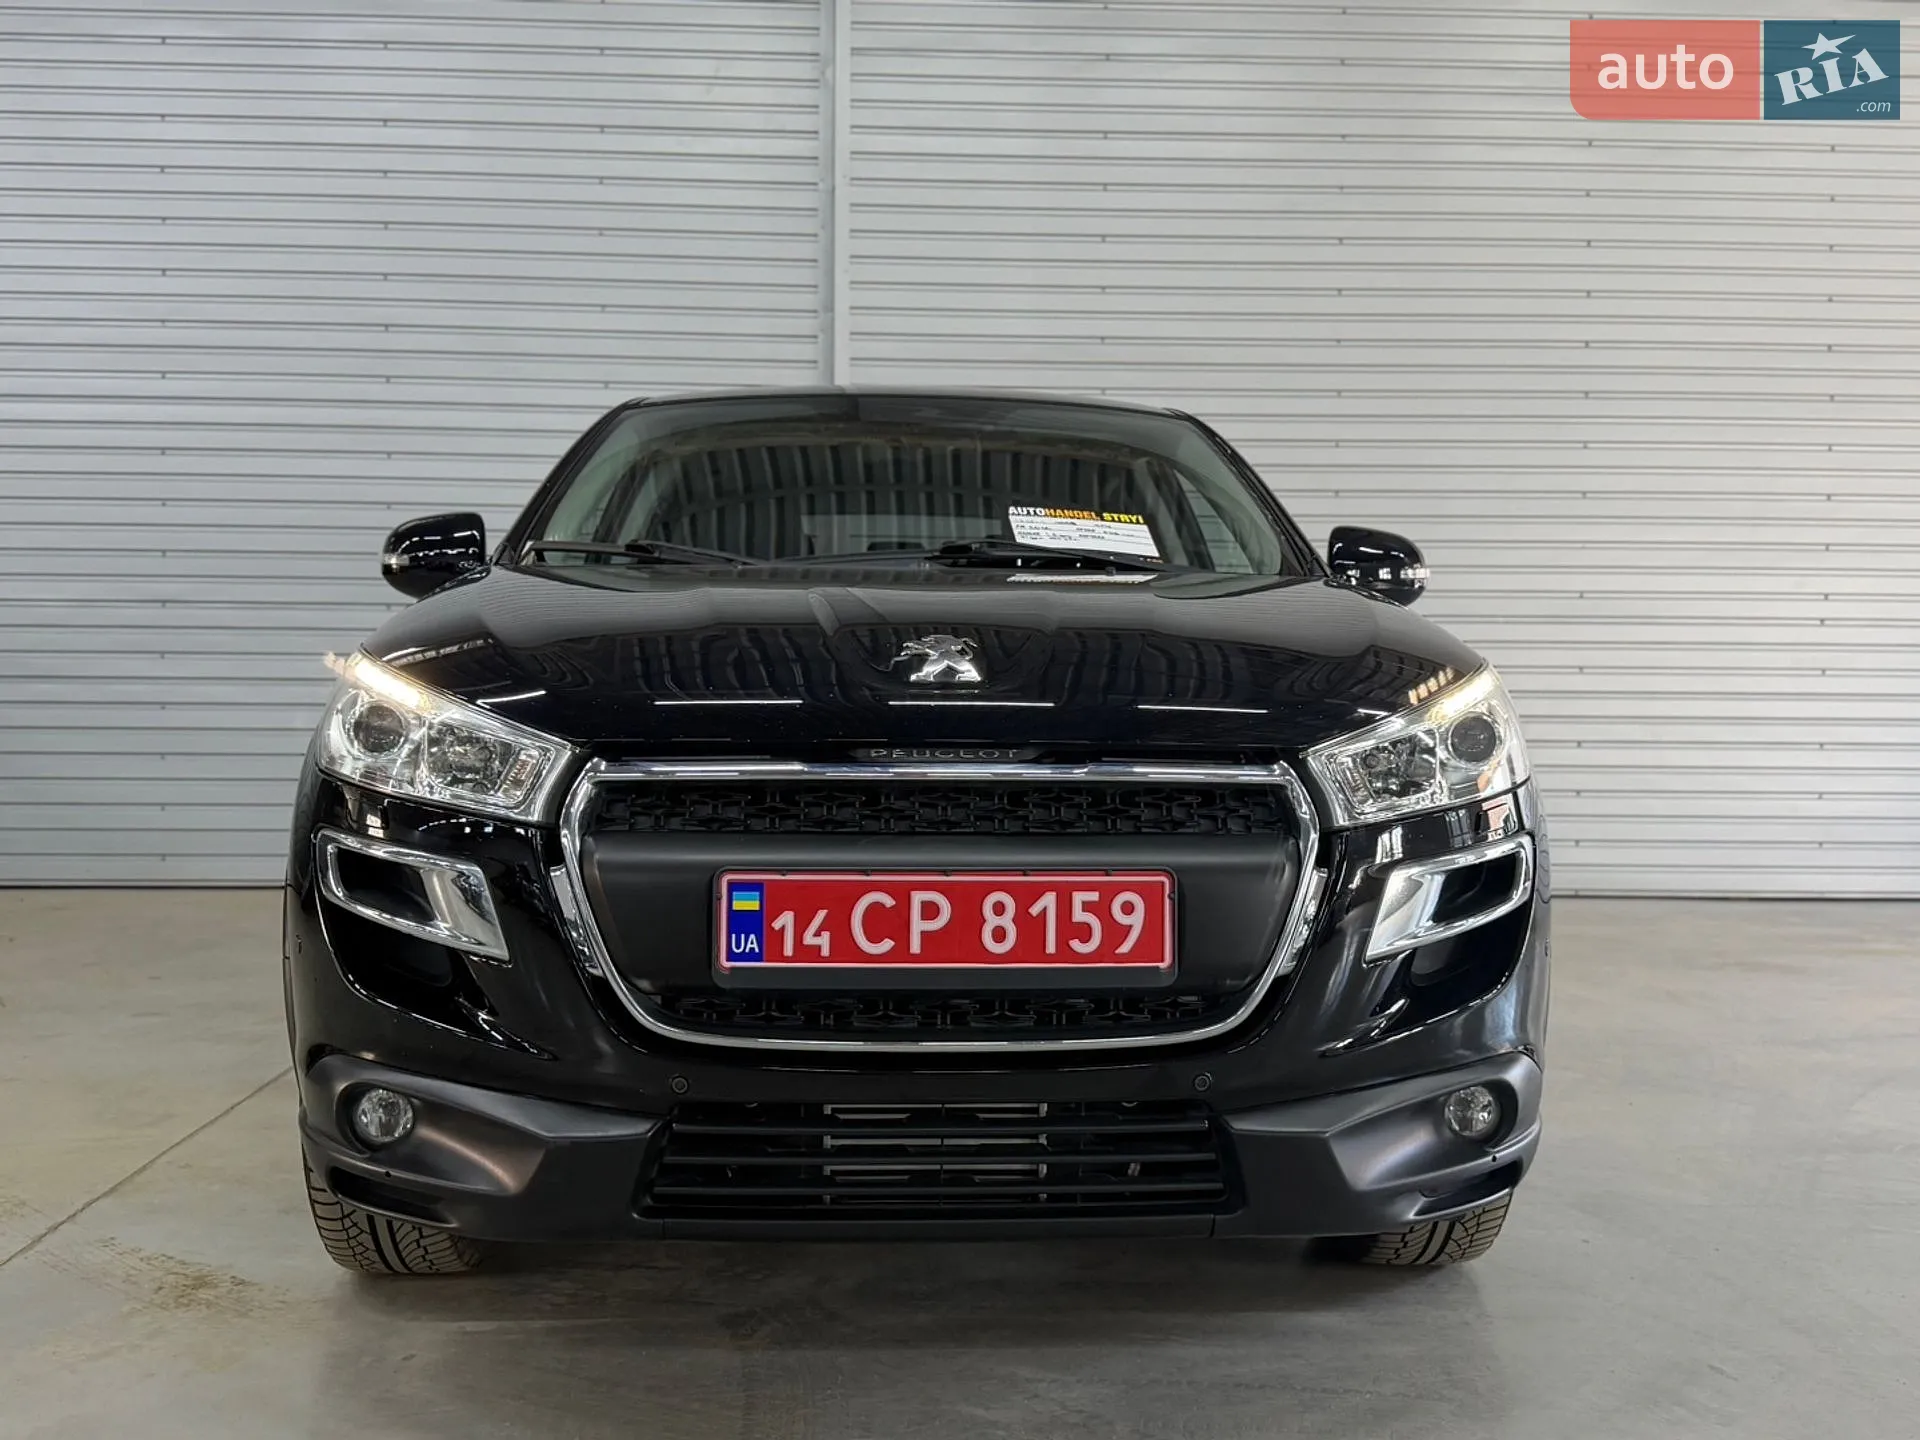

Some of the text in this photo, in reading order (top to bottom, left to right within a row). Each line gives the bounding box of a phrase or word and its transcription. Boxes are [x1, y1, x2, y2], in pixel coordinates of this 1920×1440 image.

[1009, 506, 1100, 520] AUTOHANDEL
[870, 748, 1019, 759] PEUGEOT
[770, 890, 1146, 957] 14 CP 8159
[731, 933, 760, 954] UA
